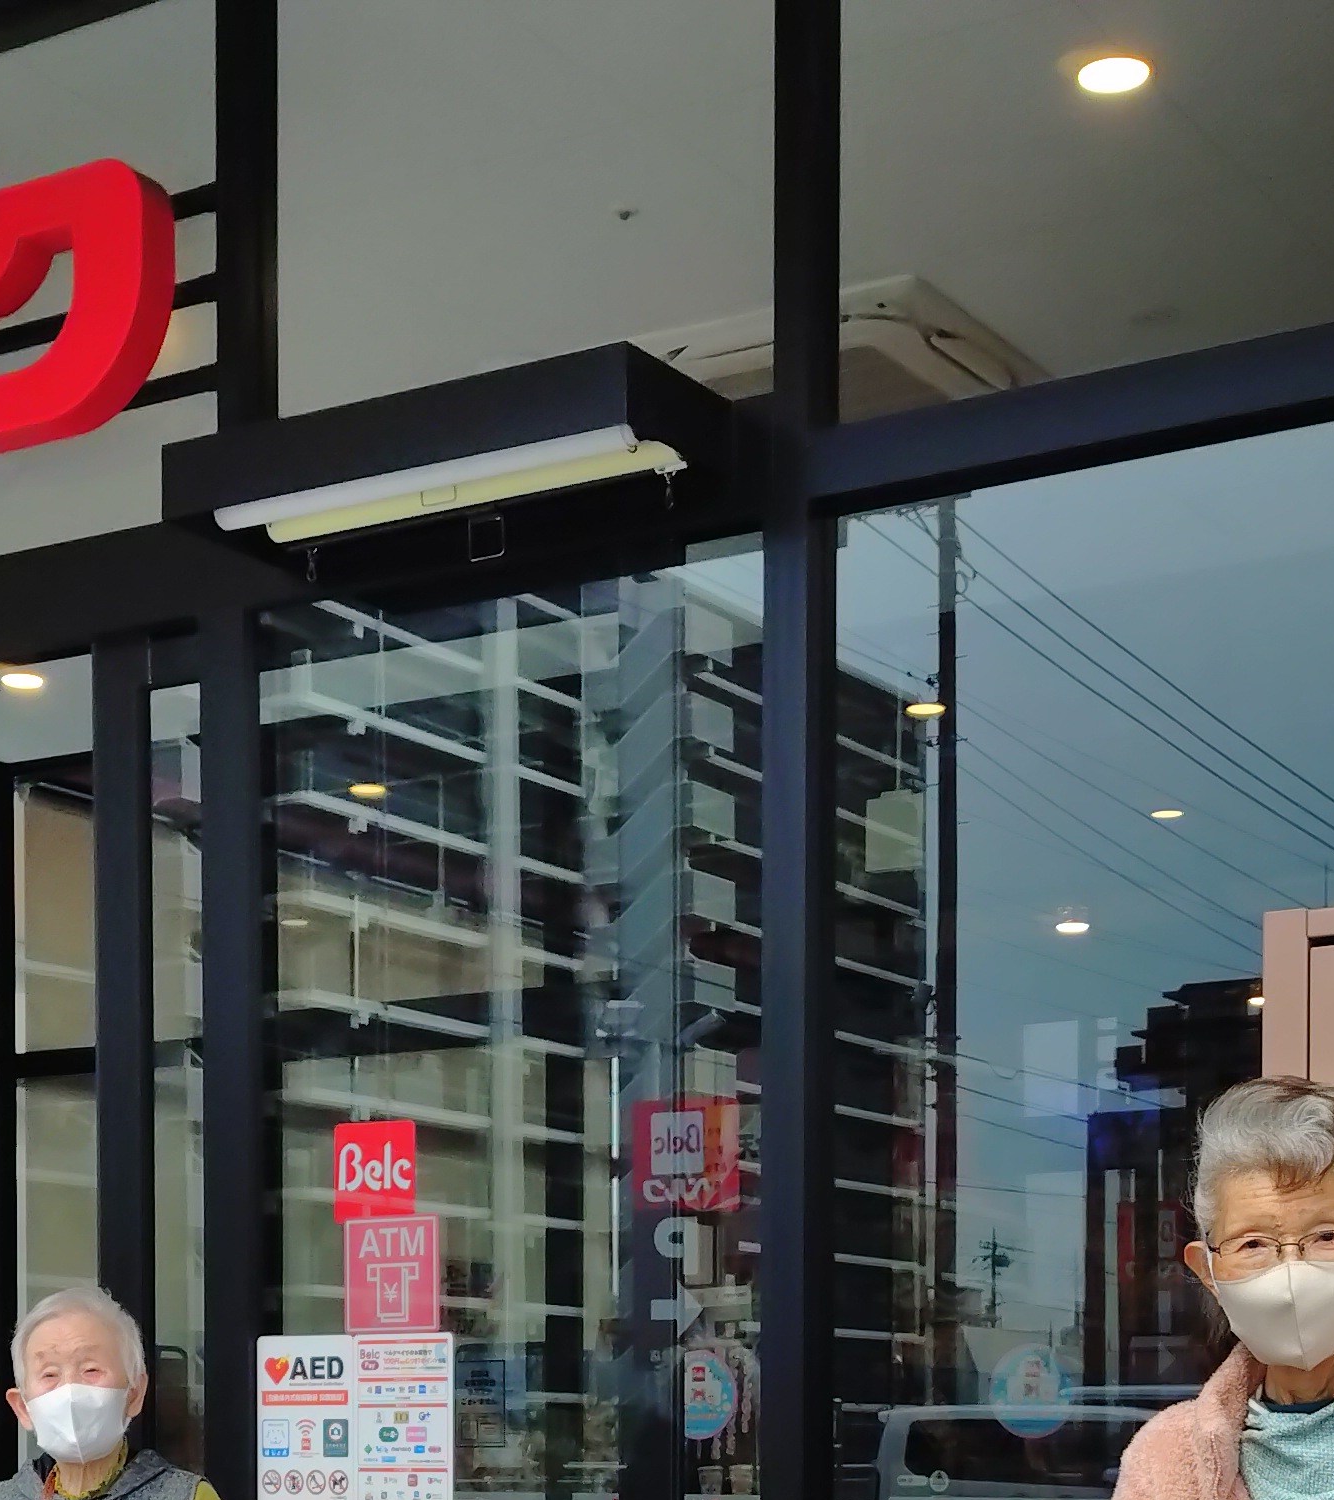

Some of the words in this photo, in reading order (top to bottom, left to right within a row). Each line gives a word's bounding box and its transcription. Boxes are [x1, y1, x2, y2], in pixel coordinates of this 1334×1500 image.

[339, 1141, 412, 1192] Belc
[358, 1226, 425, 1260] ATM
[289, 1356, 344, 1380] AED
